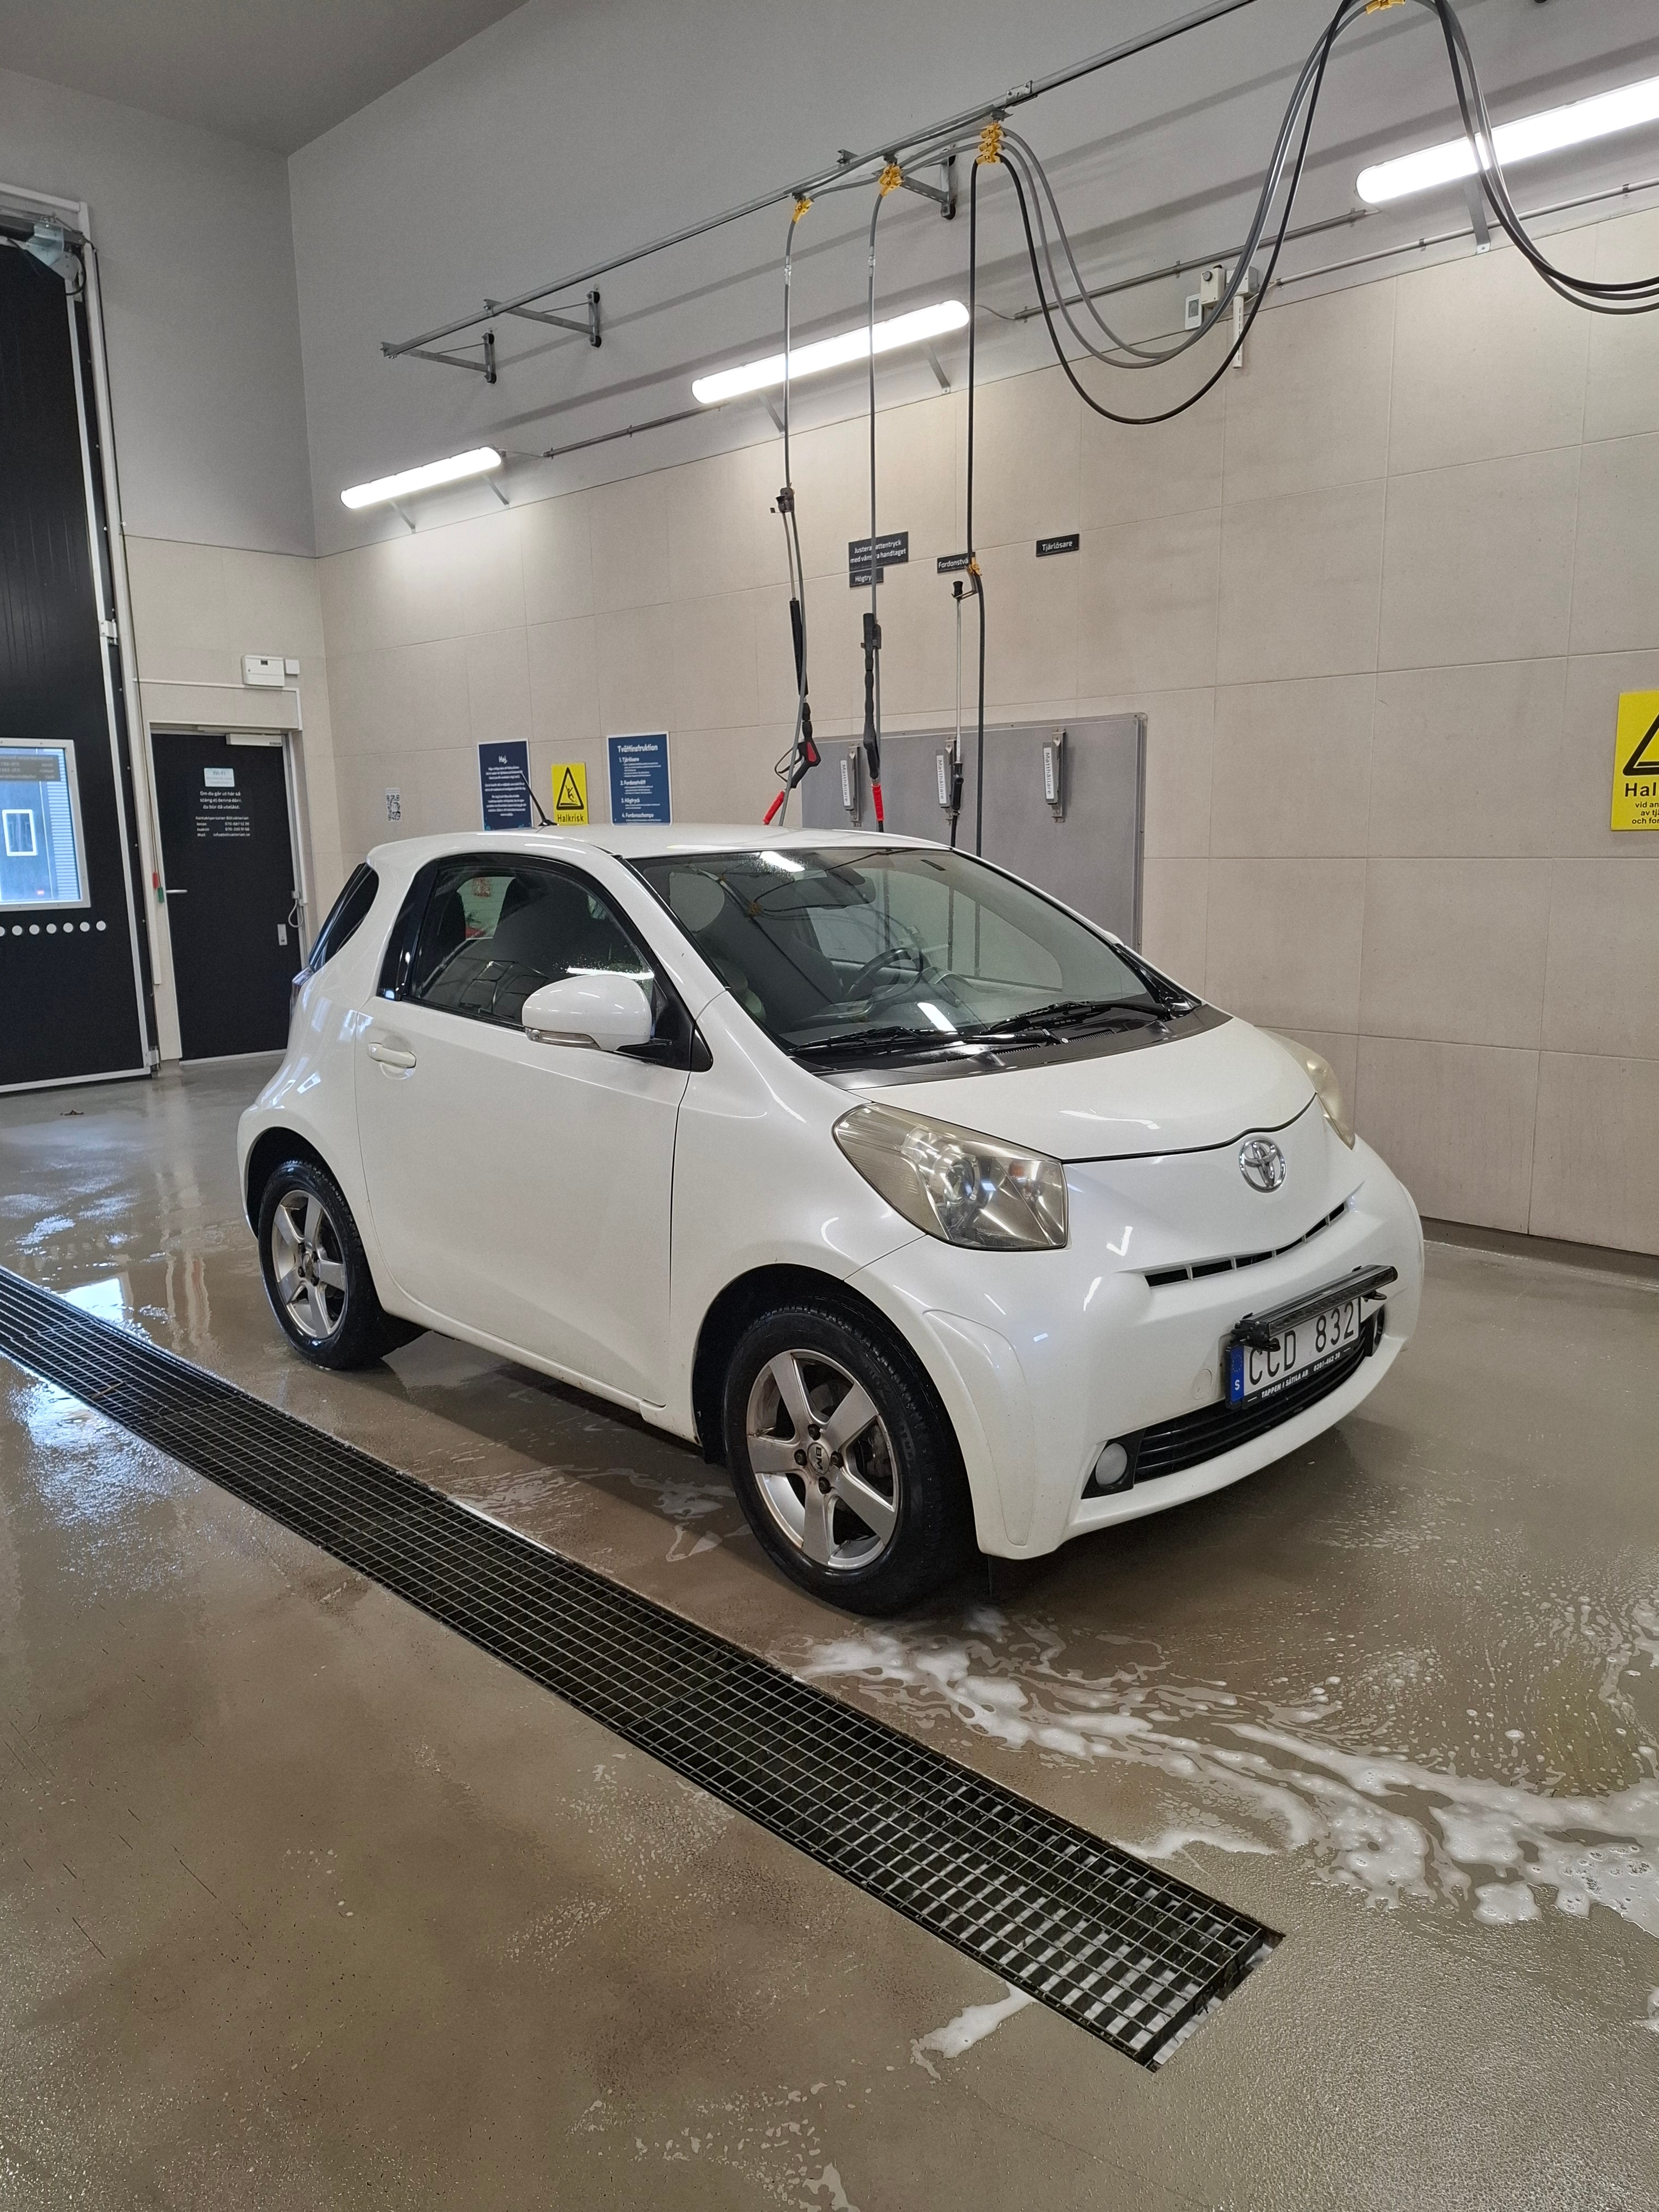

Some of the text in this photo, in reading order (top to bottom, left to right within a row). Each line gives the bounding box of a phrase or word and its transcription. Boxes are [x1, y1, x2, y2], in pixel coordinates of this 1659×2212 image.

[875, 539, 902, 549] attentryck
[1042, 541, 1073, 552] Tjärlösare
[861, 554, 880, 562] vänsa
[880, 548, 906, 558] handtaget
[938, 557, 969, 568] Fordonstvä
[617, 744, 658, 753] Tvättinstruktion
[1625, 782, 1657, 797] Hal
[557, 814, 584, 822] Halkrisk
[1249, 1301, 1354, 1385] CCD 832
[1234, 1379, 1240, 1391] S
